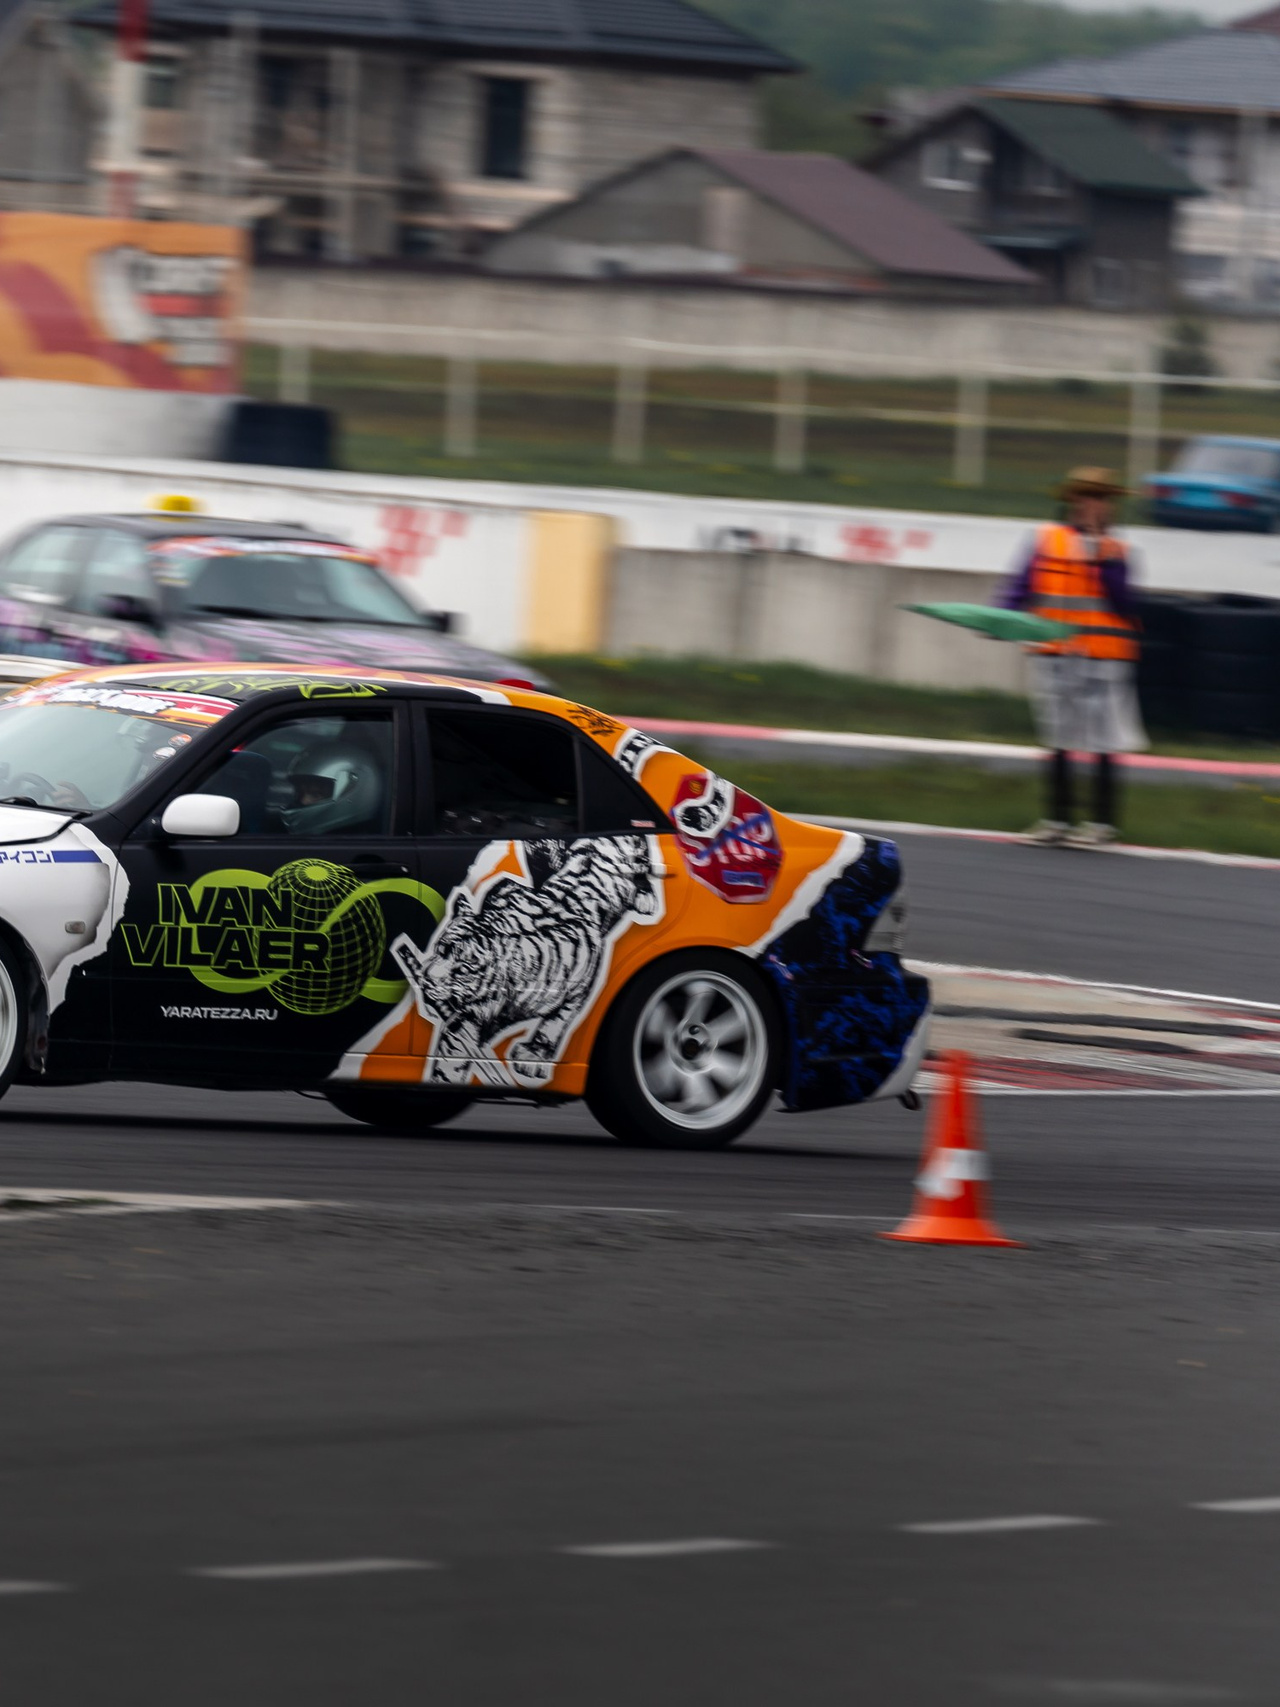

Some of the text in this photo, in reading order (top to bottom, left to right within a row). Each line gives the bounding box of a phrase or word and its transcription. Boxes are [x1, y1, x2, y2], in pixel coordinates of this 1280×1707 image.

[157, 883, 294, 929] IVAN
[121, 923, 331, 972] VILAER
[160, 1005, 278, 1020] YARATEZZA.RU
